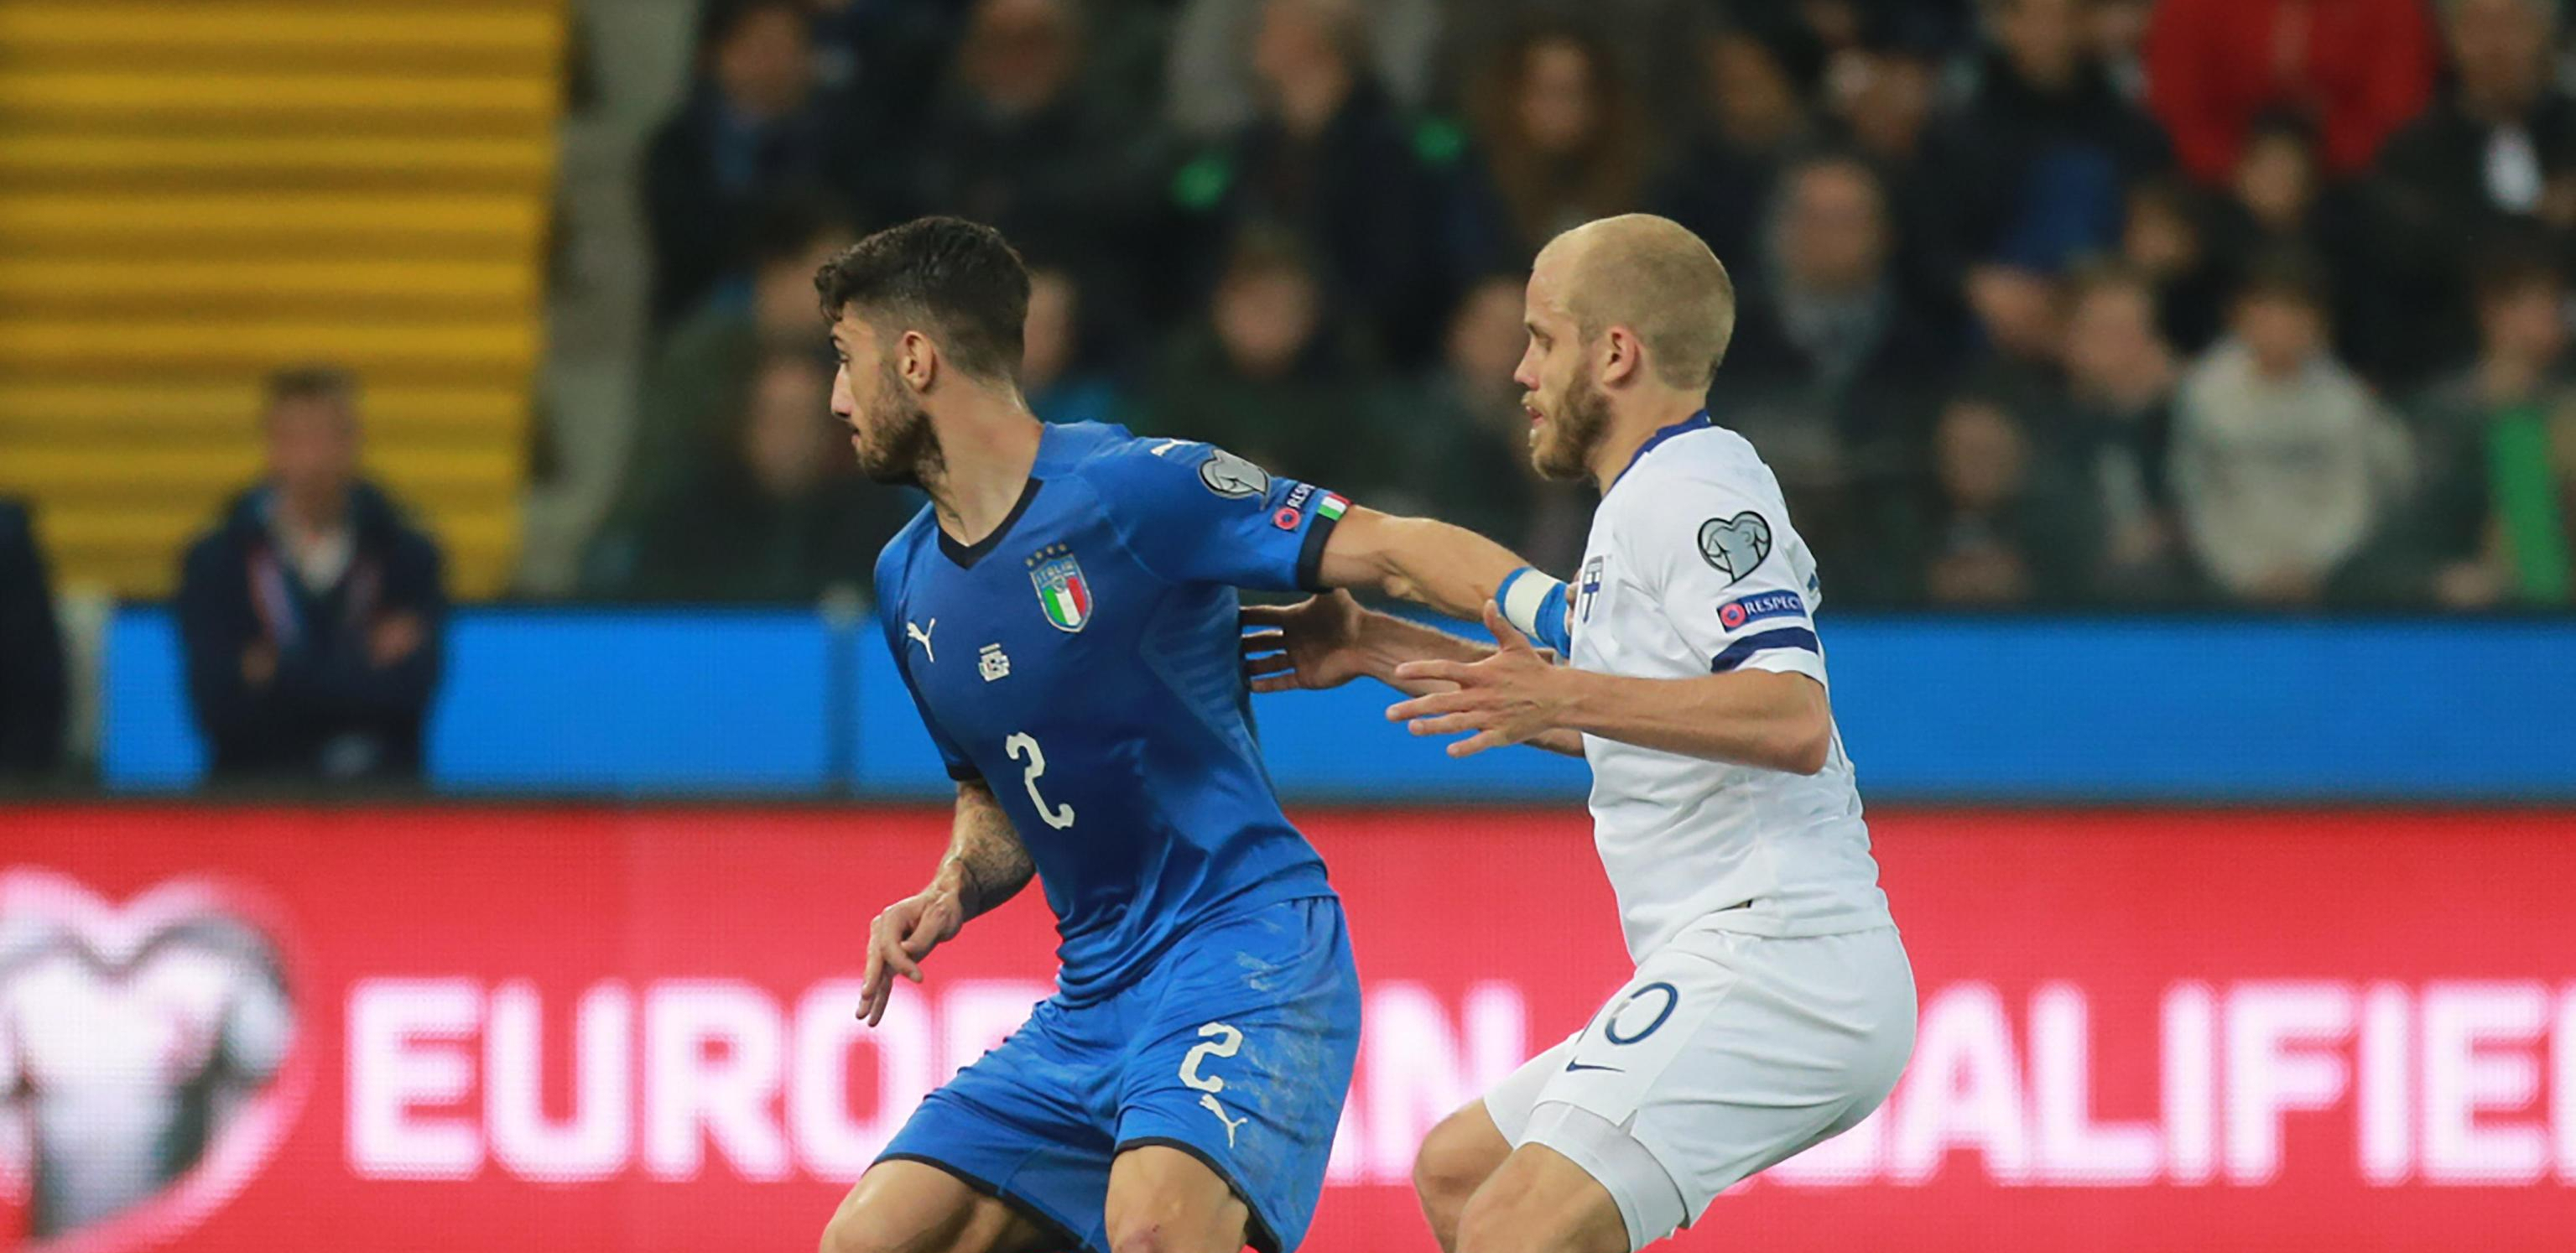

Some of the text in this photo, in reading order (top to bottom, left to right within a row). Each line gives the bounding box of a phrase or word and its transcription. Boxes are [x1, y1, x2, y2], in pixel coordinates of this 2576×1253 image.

[1744, 595, 1803, 616] RESPEC
[1006, 731, 1075, 829] 2
[1178, 1021, 1244, 1094] 2
